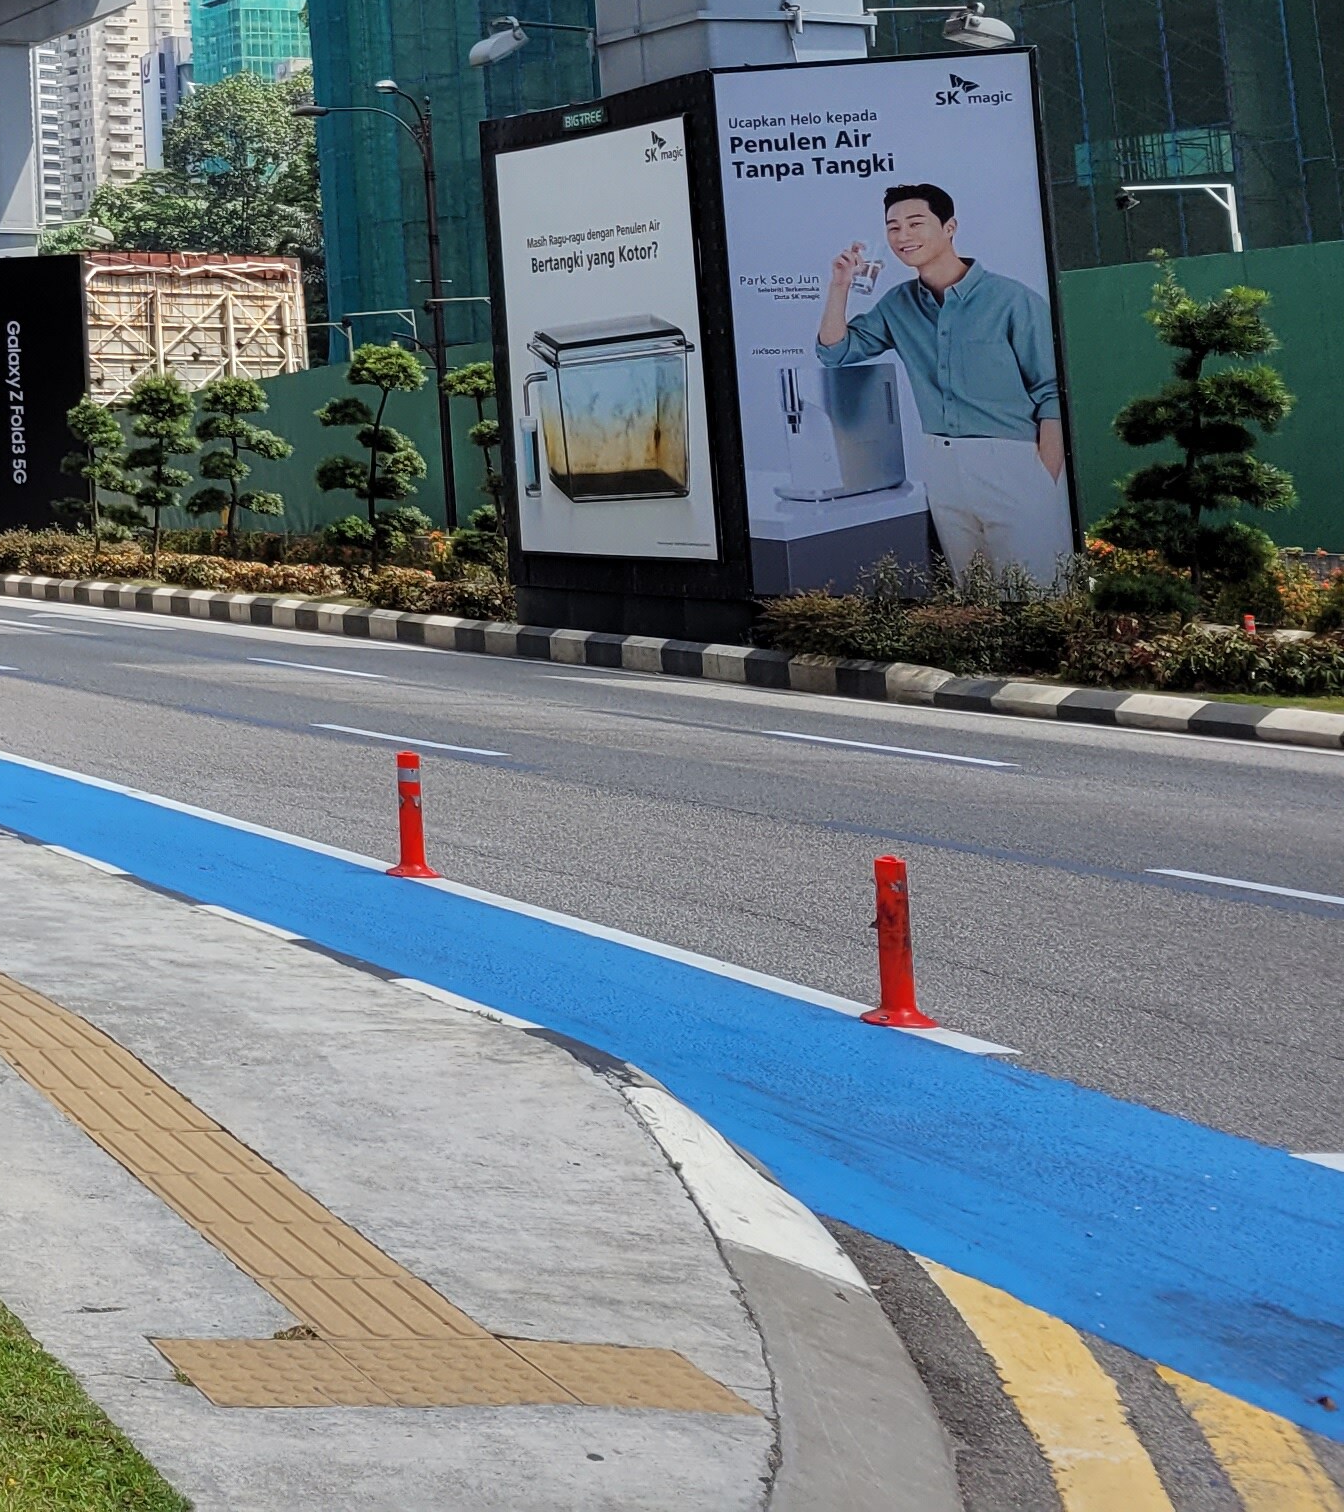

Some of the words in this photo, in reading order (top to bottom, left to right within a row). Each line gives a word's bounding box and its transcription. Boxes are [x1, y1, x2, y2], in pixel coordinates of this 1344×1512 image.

[935, 91, 961, 105] SK
[968, 90, 1013, 106] magic
[728, 115, 786, 130] Ucapkan
[791, 112, 822, 126] Helo
[827, 109, 877, 126] kepada
[730, 132, 827, 154] Penulen
[835, 129, 872, 149] Air
[645, 147, 658, 163] SK
[661, 146, 683, 161] magic
[732, 161, 805, 182] Tanpa
[811, 153, 895, 178] Tangki
[527, 235, 548, 249] Masih
[549, 232, 585, 248] Ragu-ragu
[587, 228, 615, 242] dengan
[616, 222, 647, 237] Penulen
[648, 219, 661, 232] Air
[531, 250, 583, 273] Bertangki
[586, 250, 615, 271] yang
[618, 241, 659, 263] Kotor?
[739, 274, 767, 285] Park
[771, 275, 793, 285] Seo
[798, 274, 820, 284] Jun
[5, 320, 22, 388] Galaxy
[9, 390, 24, 402] Z
[10, 405, 26, 454] Fold3
[12, 459, 28, 485] 5G
